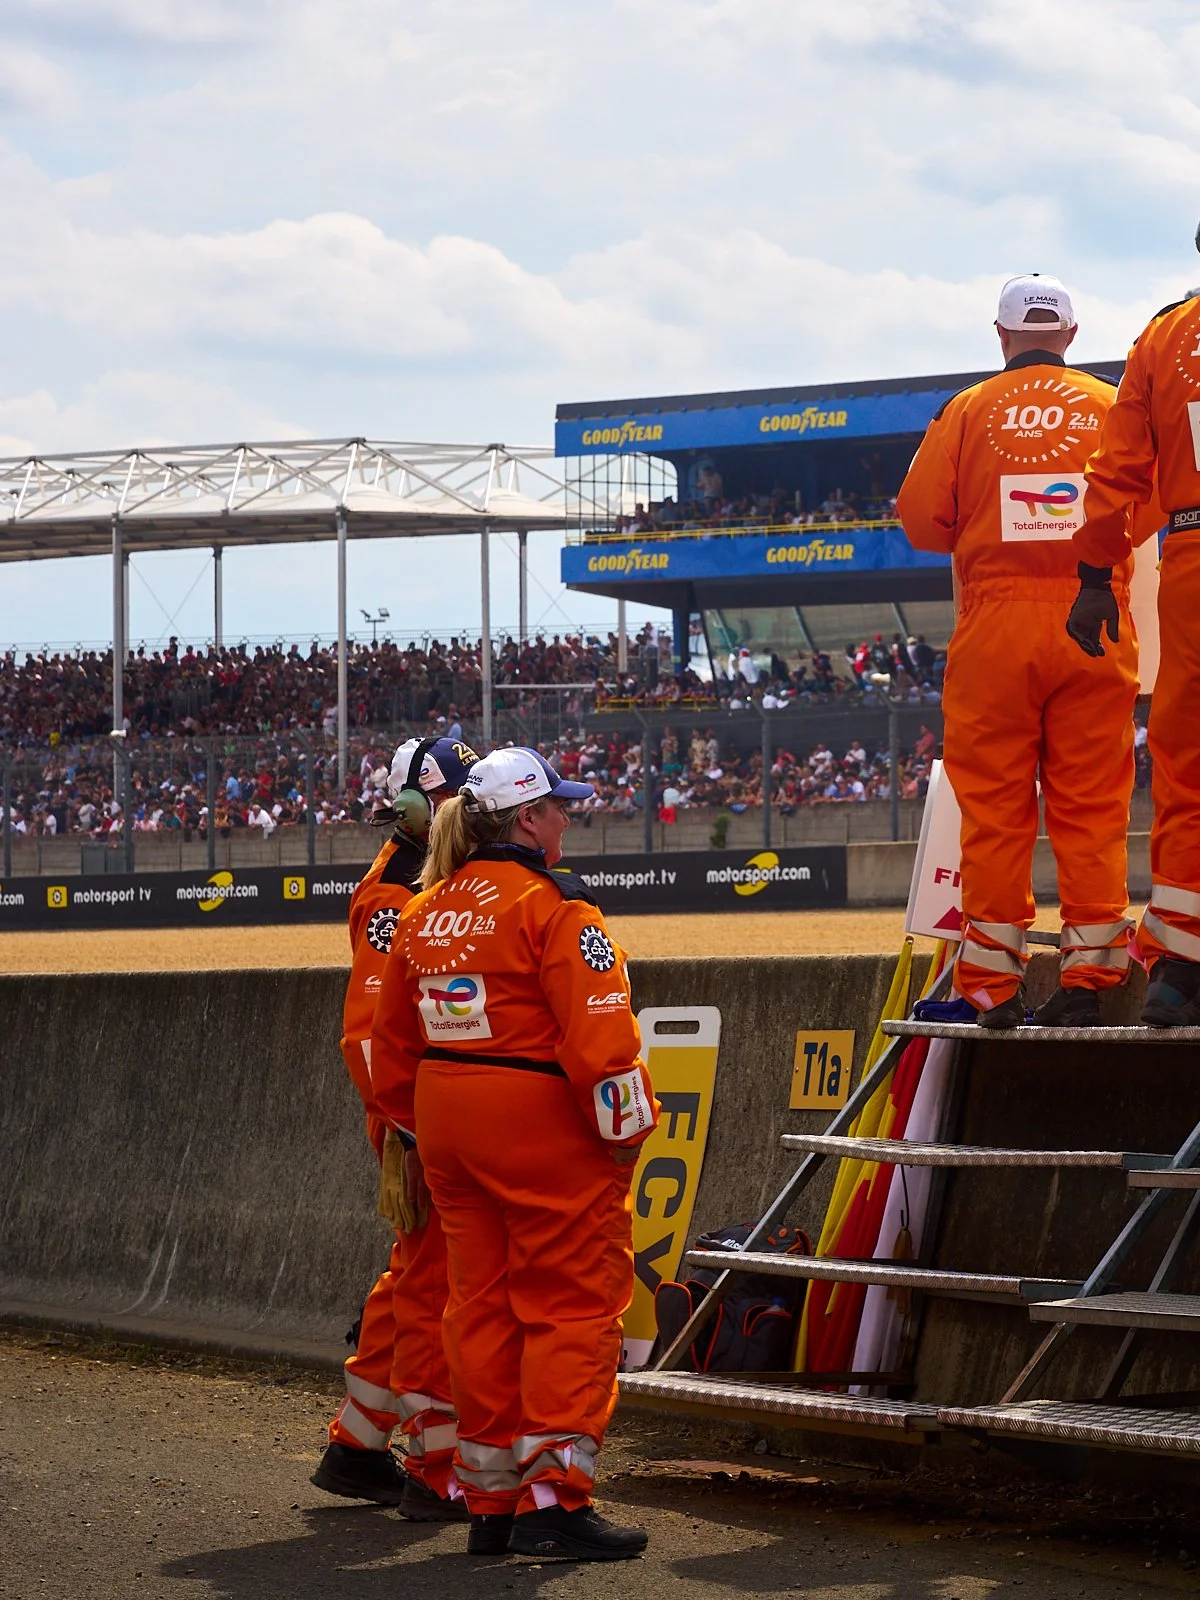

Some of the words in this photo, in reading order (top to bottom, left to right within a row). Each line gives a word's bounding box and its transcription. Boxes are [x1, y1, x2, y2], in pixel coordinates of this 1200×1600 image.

[760, 407, 847, 434] GOODYEAR
[1001, 405, 1064, 430] 100
[582, 421, 663, 447] GOODYEAR
[1014, 430, 1043, 438] ANS
[1013, 520, 1077, 531] TotalEnergies
[588, 549, 669, 575] GOODYEAR
[767, 540, 854, 566] GOODYEAR
[580, 869, 676, 890] motorsport.tv
[707, 867, 811, 885] motorsport.com
[73, 888, 134, 905] motorsport
[140, 887, 152, 901] tv
[176, 884, 258, 901] motorsport.com
[313, 882, 360, 896] motors
[417, 910, 473, 937] 100
[426, 938, 451, 947] ANS
[587, 992, 627, 1006] WEC
[430, 1020, 480, 1030] TotalEnergies
[803, 1042, 841, 1096] T1a
[631, 1076, 645, 1128] TotalEnergies
[634, 1092, 700, 1297] FCY
